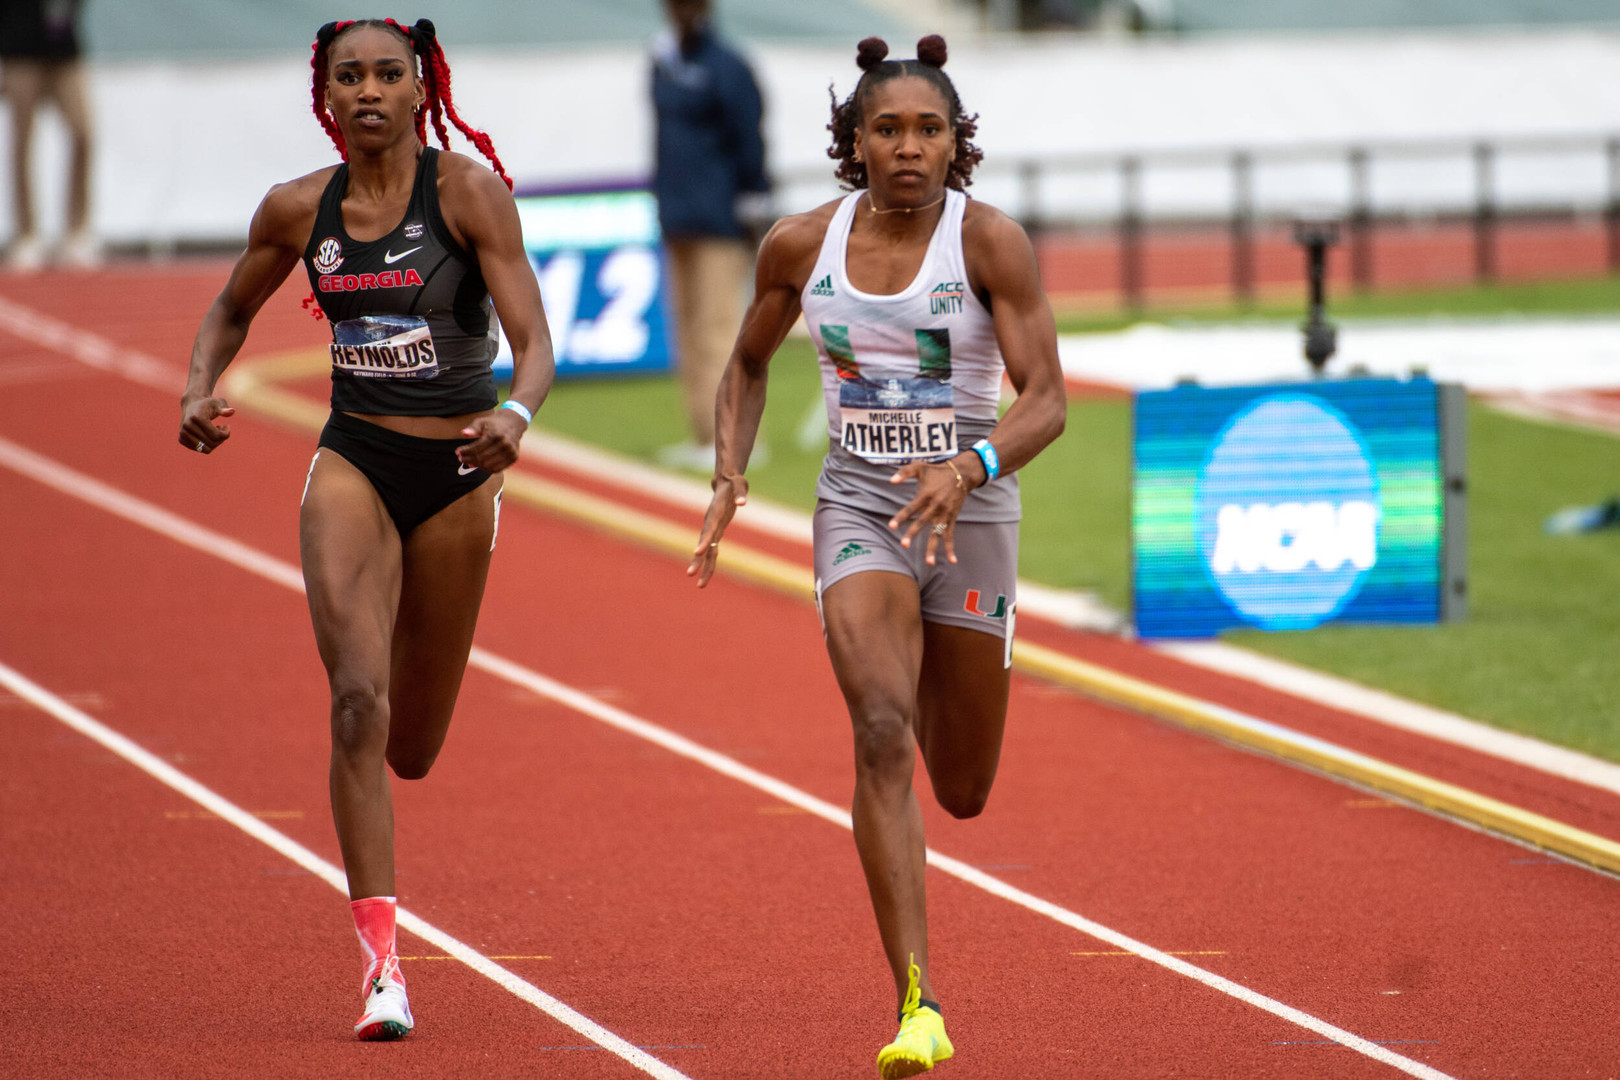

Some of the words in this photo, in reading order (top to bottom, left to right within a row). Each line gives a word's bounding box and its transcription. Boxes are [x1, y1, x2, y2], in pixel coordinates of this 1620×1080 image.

[318, 239, 340, 266] SEC
[318, 268, 425, 292] GEORGIA
[931, 282, 964, 293] ACC
[810, 288, 835, 297] adidas
[930, 295, 964, 315] UNITY
[330, 339, 435, 369] REYNOLDS
[868, 412, 923, 424] MICHELLE
[844, 421, 956, 453] ATHERLEY
[1211, 501, 1377, 574] NCAA
